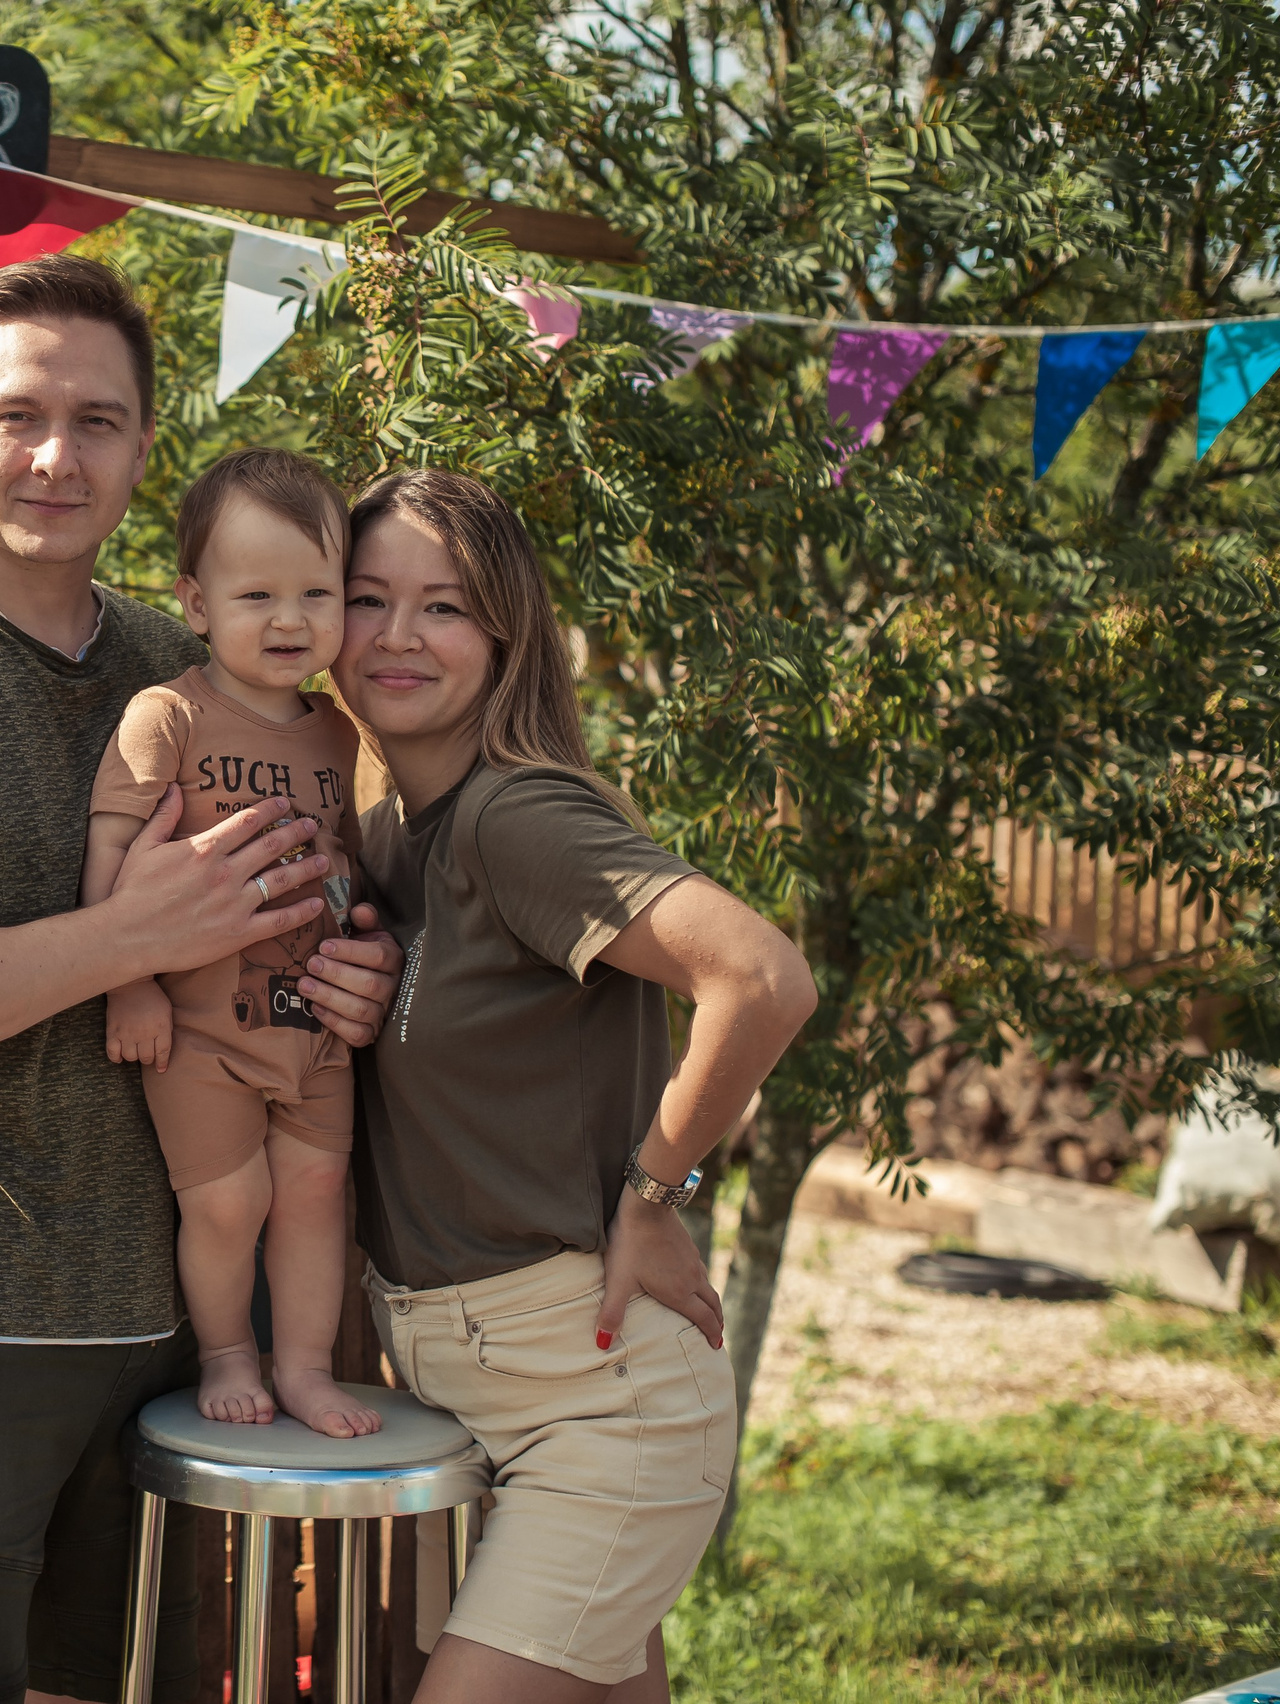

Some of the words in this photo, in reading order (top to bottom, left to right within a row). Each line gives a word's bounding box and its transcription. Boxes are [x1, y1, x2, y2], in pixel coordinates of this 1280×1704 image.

[198, 755, 297, 799] SUCH
[314, 767, 344, 809] FU
[403, 987, 415, 1016] SINCE
[400, 1019, 409, 1043] 1966
